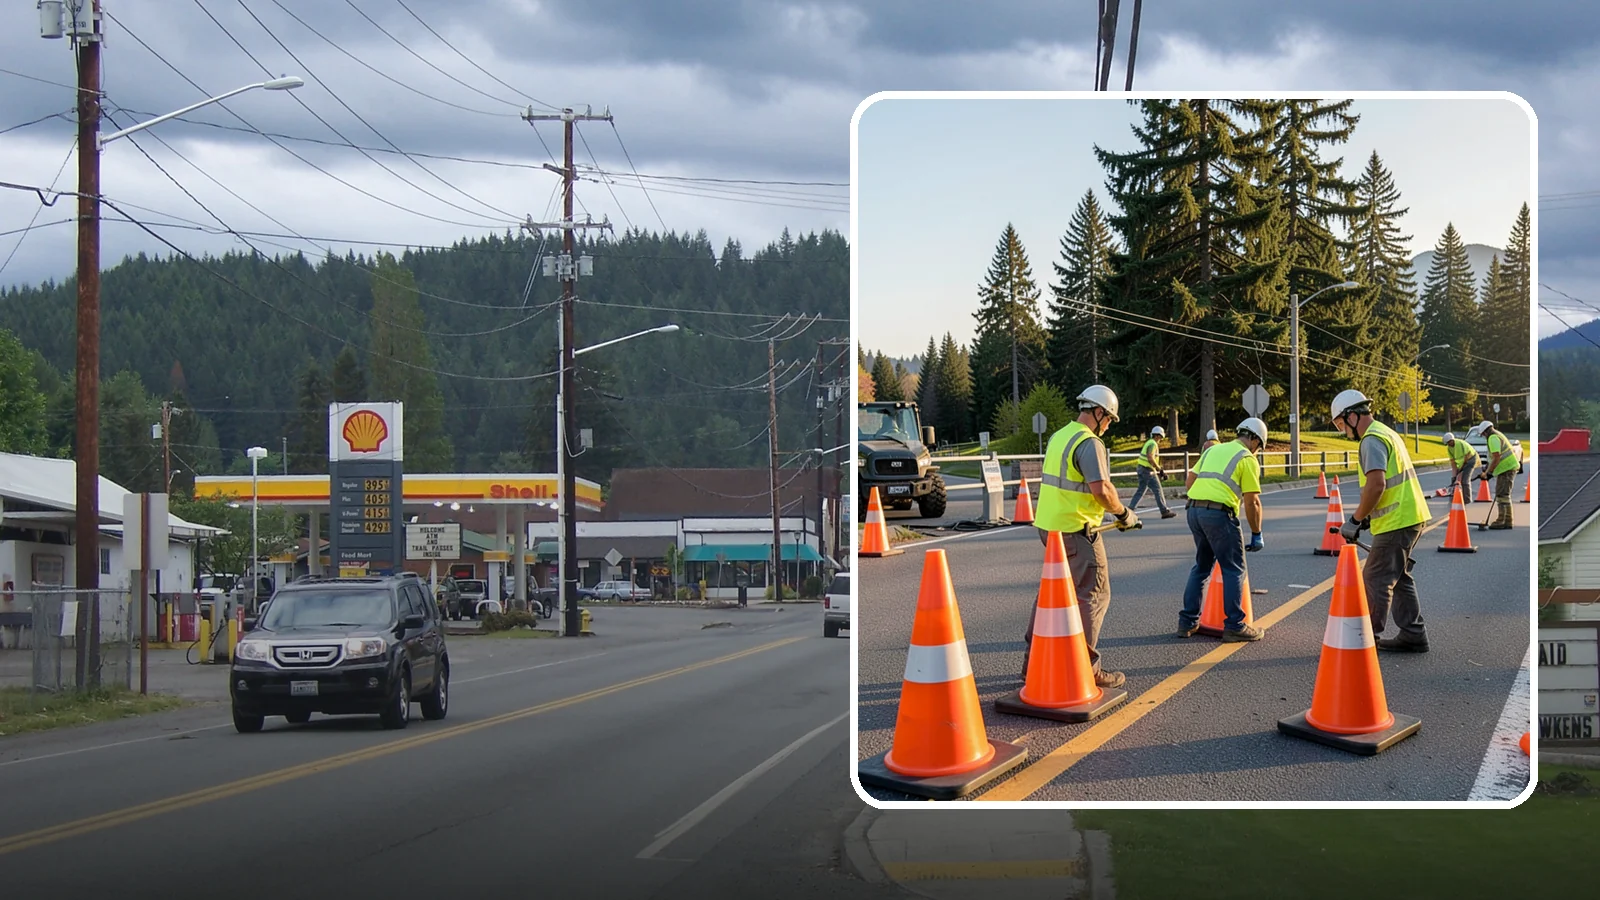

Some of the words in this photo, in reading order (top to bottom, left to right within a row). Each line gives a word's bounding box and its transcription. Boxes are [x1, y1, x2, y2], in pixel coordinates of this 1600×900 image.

[366, 480, 383, 490] 395
[490, 484, 547, 499] Shell
[366, 494, 383, 504] 405
[366, 508, 383, 518] 415
[366, 522, 383, 533] 429
